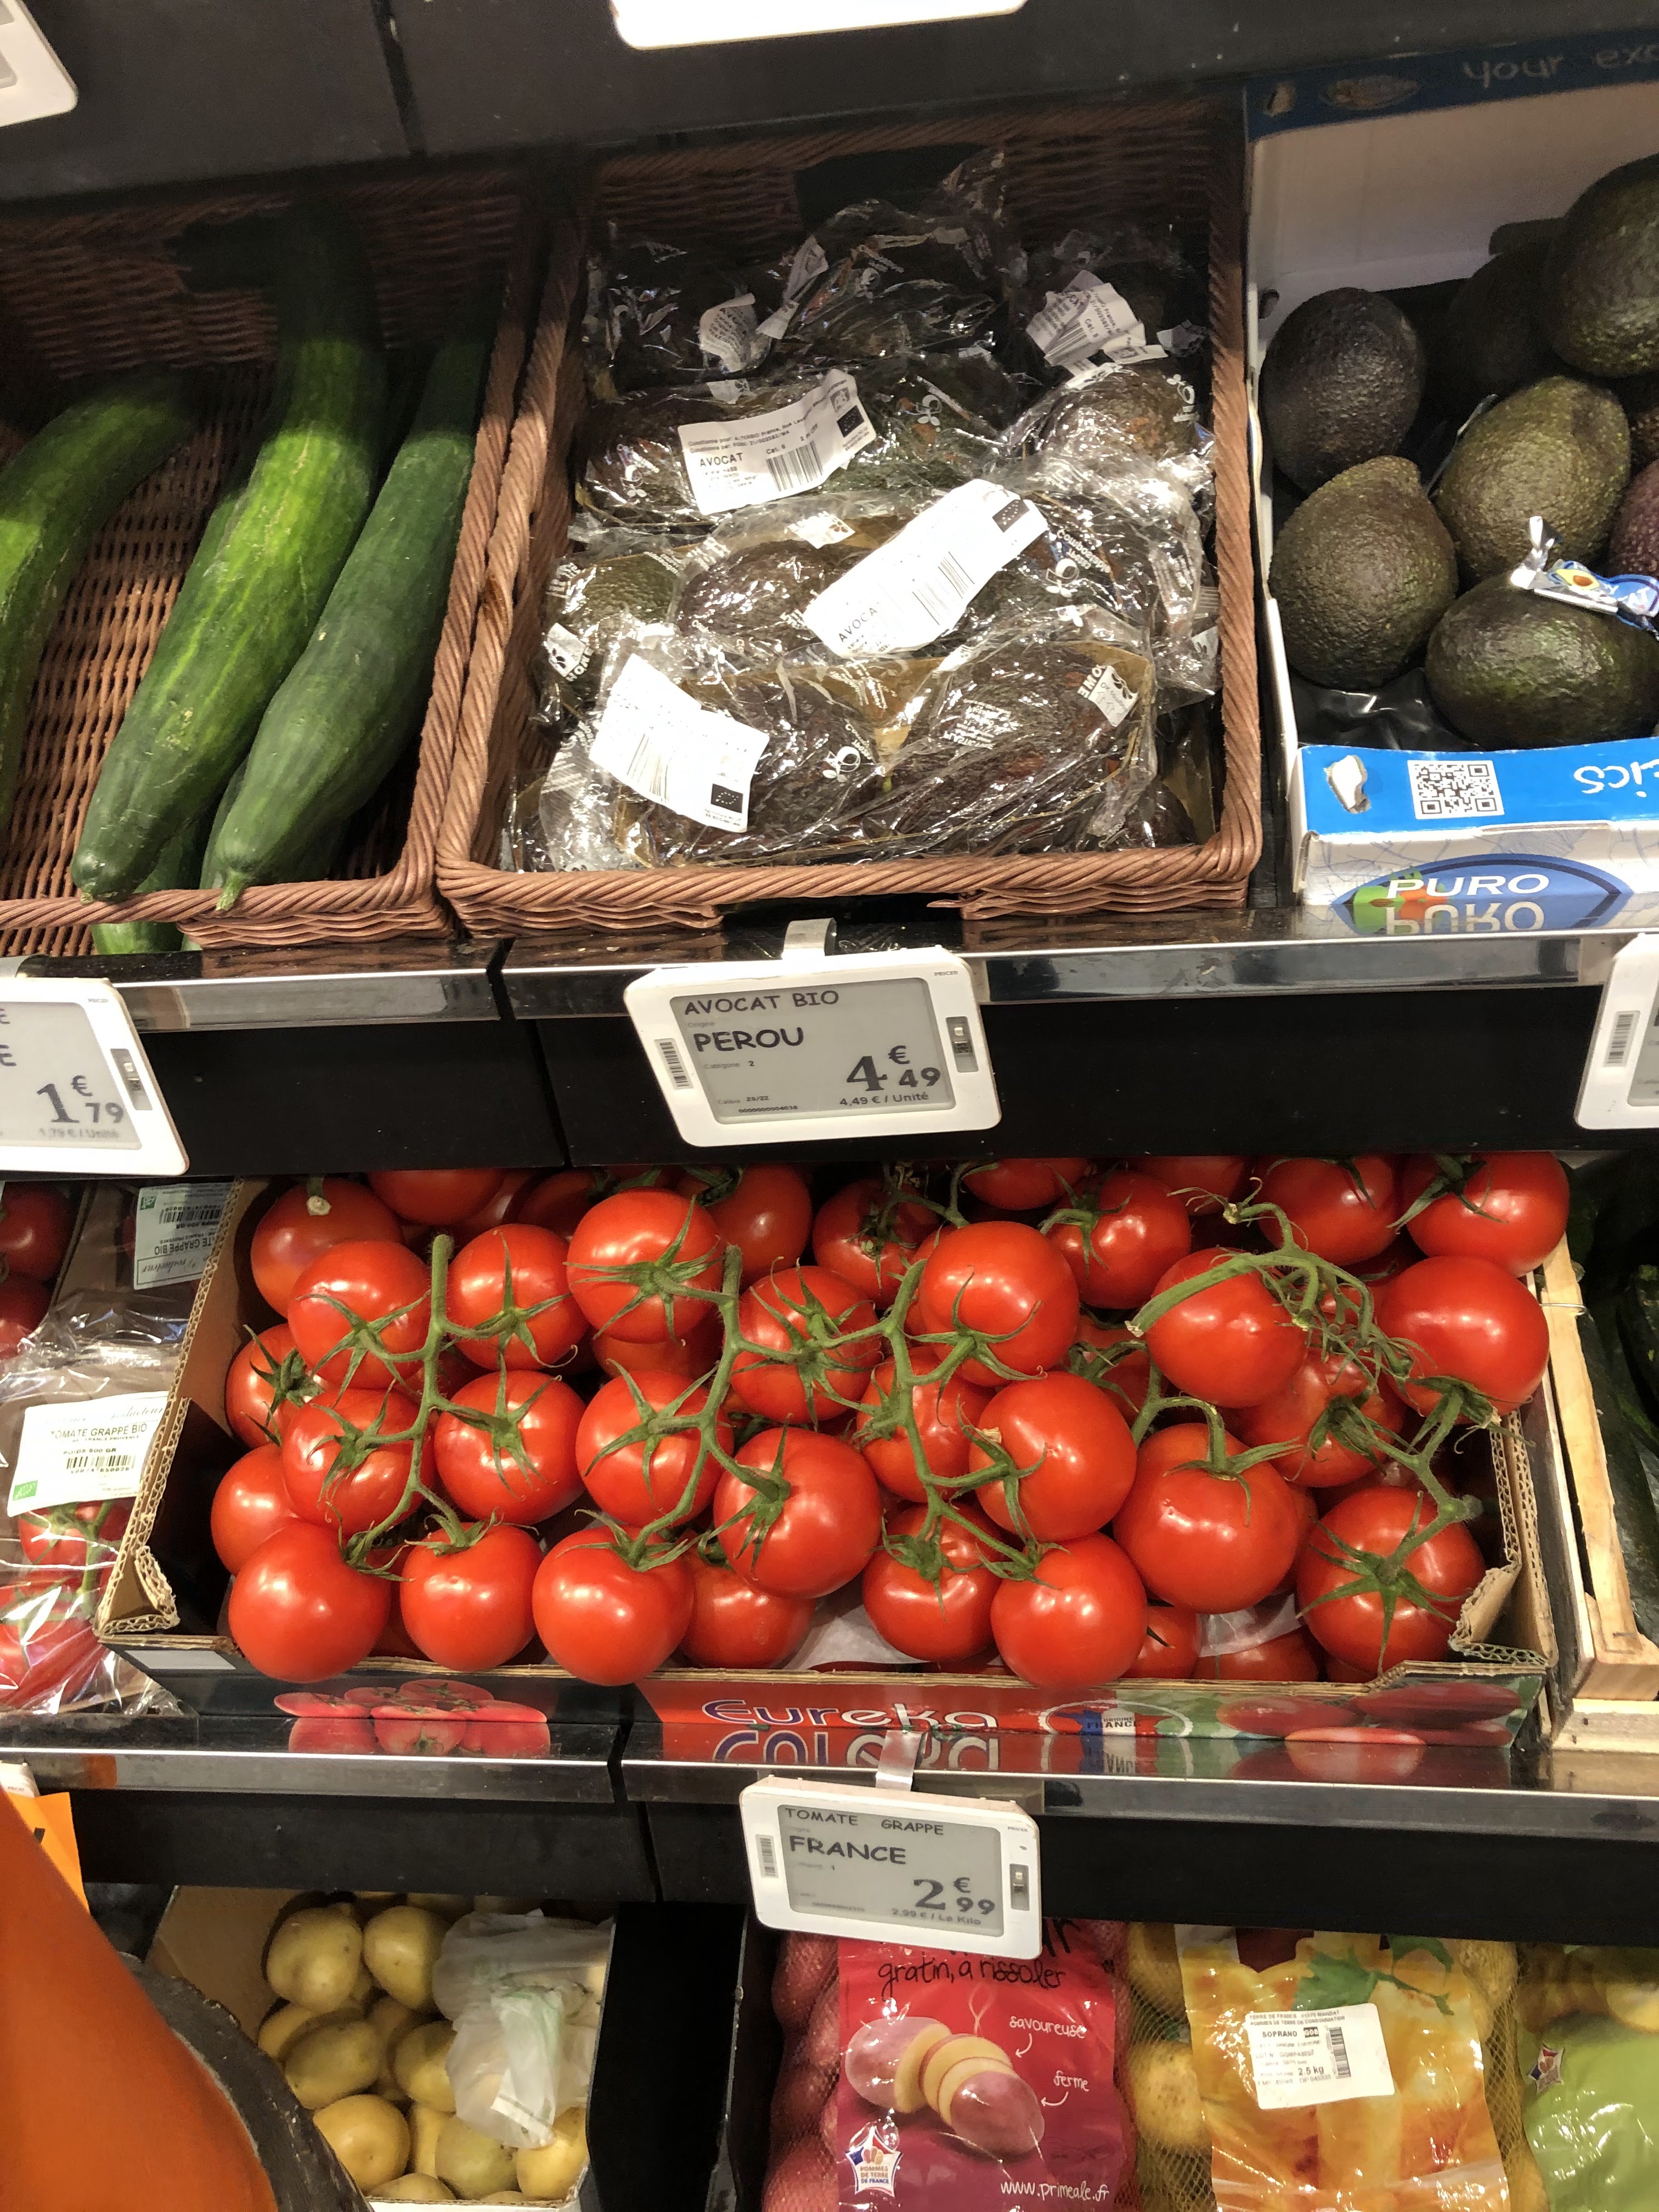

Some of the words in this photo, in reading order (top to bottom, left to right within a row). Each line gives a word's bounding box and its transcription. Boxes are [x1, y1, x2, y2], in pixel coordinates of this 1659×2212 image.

[1462, 56, 1564, 88] your
[700, 453, 743, 467] AVOCAT
[839, 605, 880, 642] AVOCA
[1386, 874, 1550, 899] PURO
[684, 995, 781, 1015] AVOCAT
[793, 990, 839, 1007] BIO
[693, 1026, 804, 1052] PEROU
[847, 1055, 887, 1091] 4
[899, 1066, 941, 1088] 49
[37, 1083, 80, 1122] 1
[85, 1102, 124, 1124] 79
[839, 1097, 868, 1107] 4,49
[893, 1092, 929, 1102] Unité
[154, 1245, 168, 1255] BIO
[170, 1238, 200, 1253] GRAPPE
[91, 1425, 129, 1436] GRAPPE
[132, 1423, 147, 1434] BIO
[702, 1699, 998, 1728] Eureka
[1087, 1720, 1141, 1729] FRANCE
[786, 1808, 859, 1826] TOMATE
[881, 1819, 944, 1836] GRAPPE
[789, 1835, 907, 1865] FRANCE
[913, 1878, 946, 1910] 2
[956, 1897, 995, 1915] 99
[979, 1957, 1066, 1989] rissoler
[1009, 2016, 1086, 2039] savoureuse
[1053, 2070, 1090, 2092] ferme
[1313, 2066, 1324, 2075] kg
[1001, 2180, 1110, 2202] www.primeale.fr
